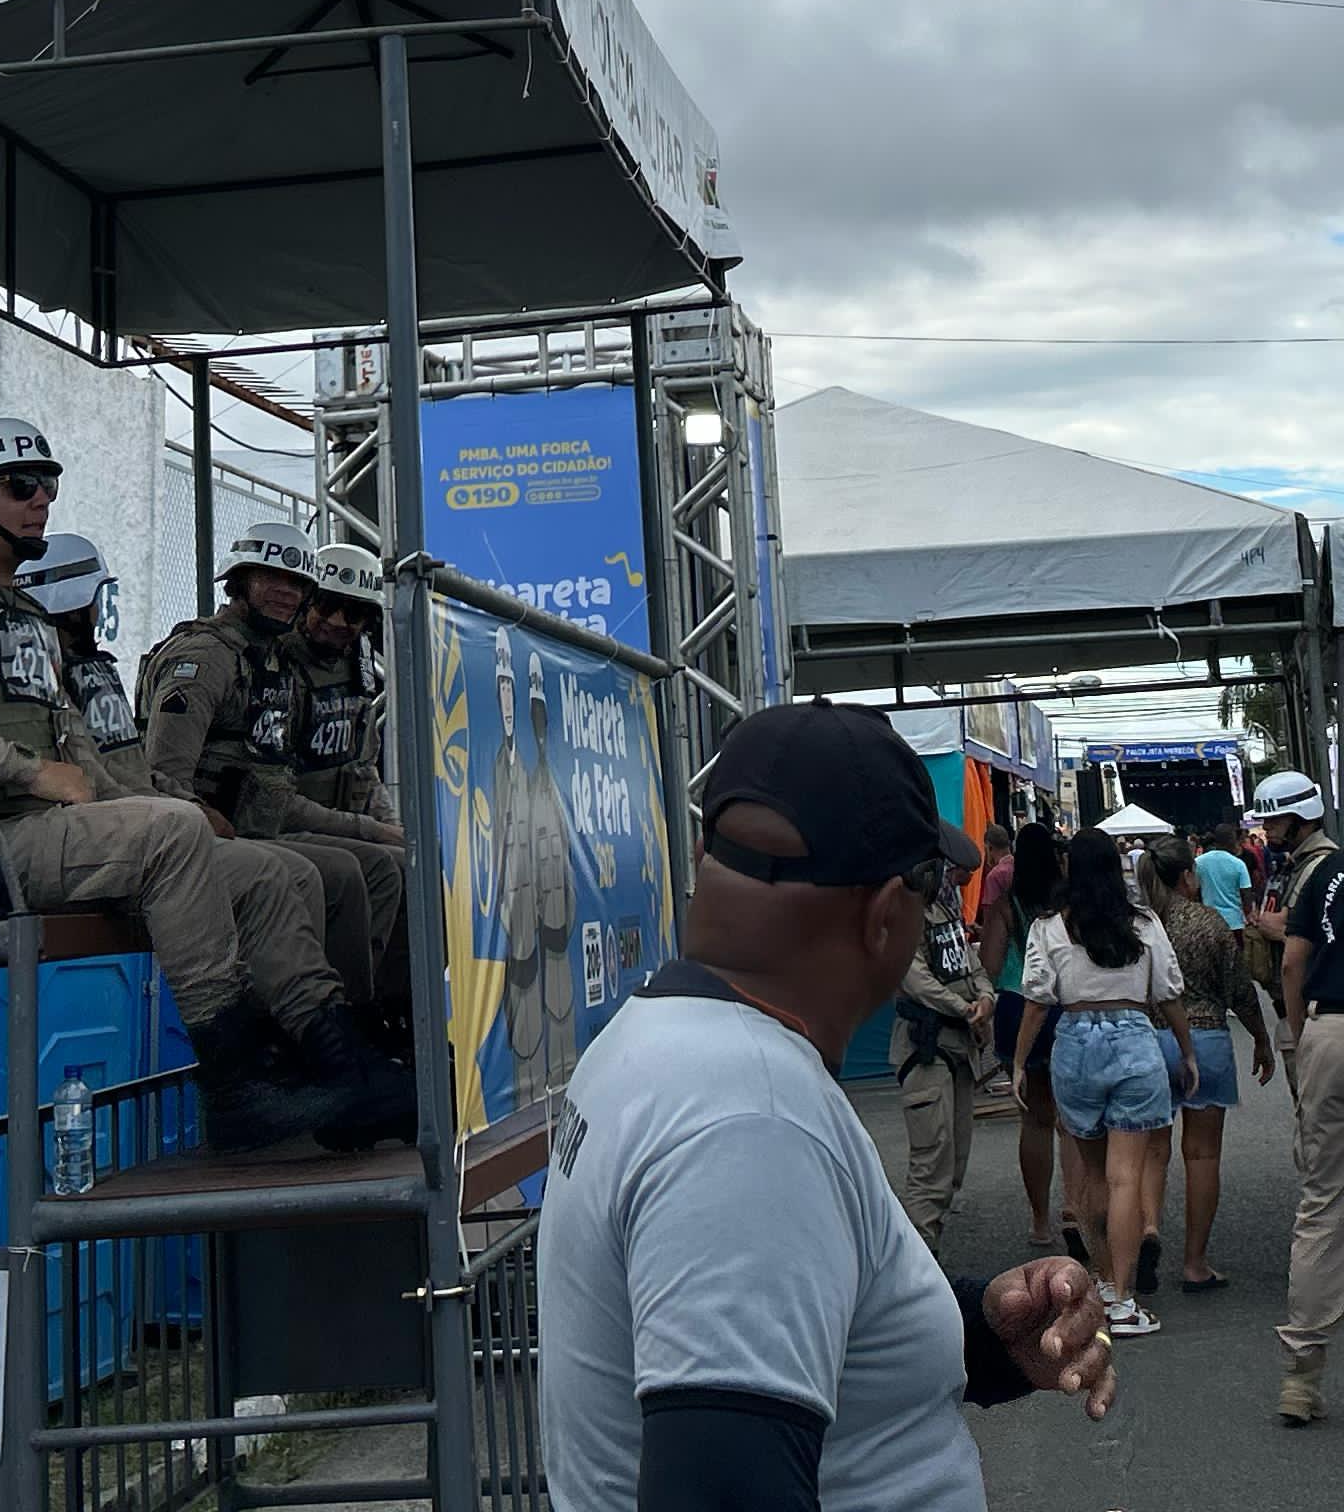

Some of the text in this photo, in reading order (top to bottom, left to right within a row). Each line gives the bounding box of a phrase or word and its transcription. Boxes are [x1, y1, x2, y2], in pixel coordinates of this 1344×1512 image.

[506, 443, 538, 458] UMA
[541, 439, 591, 457] FORÇA
[439, 468, 450, 482] A
[453, 464, 514, 481] SERVIÇO
[517, 462, 539, 477] DO
[542, 456, 612, 474] CIDADÃO!
[472, 486, 512, 505] 190
[560, 672, 627, 760] Micareta
[572, 758, 631, 836] de Feira
